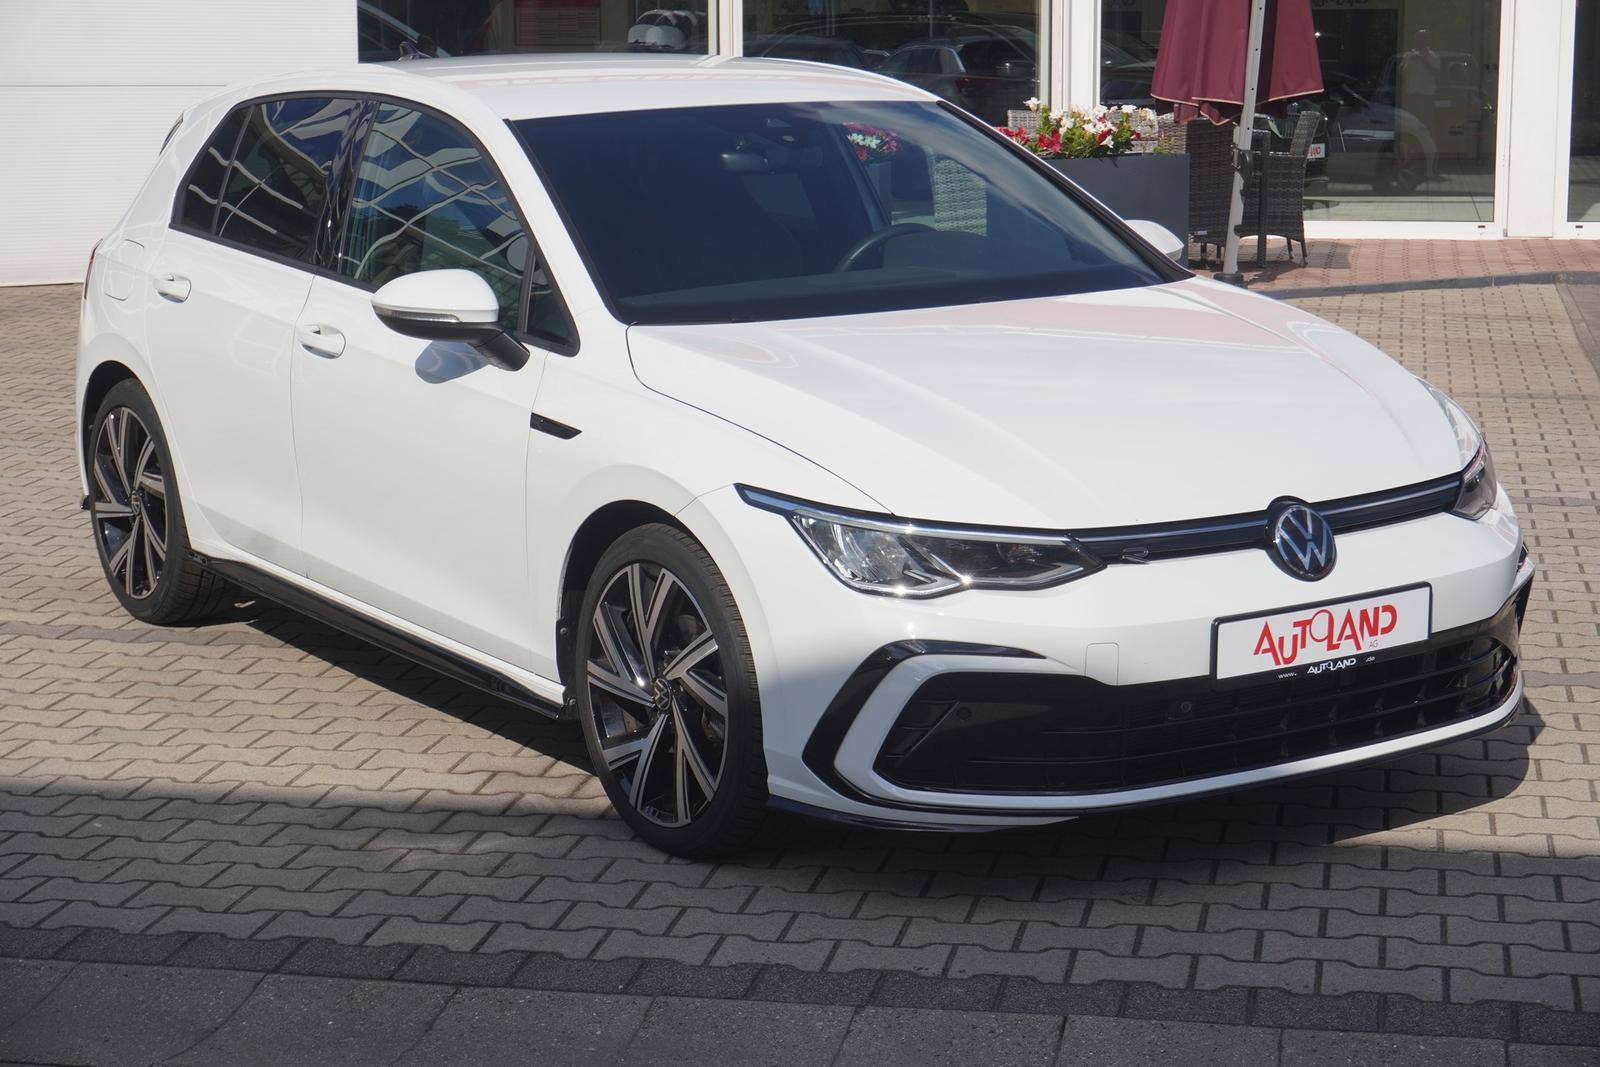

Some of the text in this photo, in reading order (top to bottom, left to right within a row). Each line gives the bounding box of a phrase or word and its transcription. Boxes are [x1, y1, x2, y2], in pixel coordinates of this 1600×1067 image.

[1276, 504, 1333, 575] VW
[1253, 604, 1398, 666] AUTOLAND
[1368, 639, 1379, 649] AG
[1278, 671, 1297, 679] www.
[1307, 658, 1357, 675] AUTOLAND
